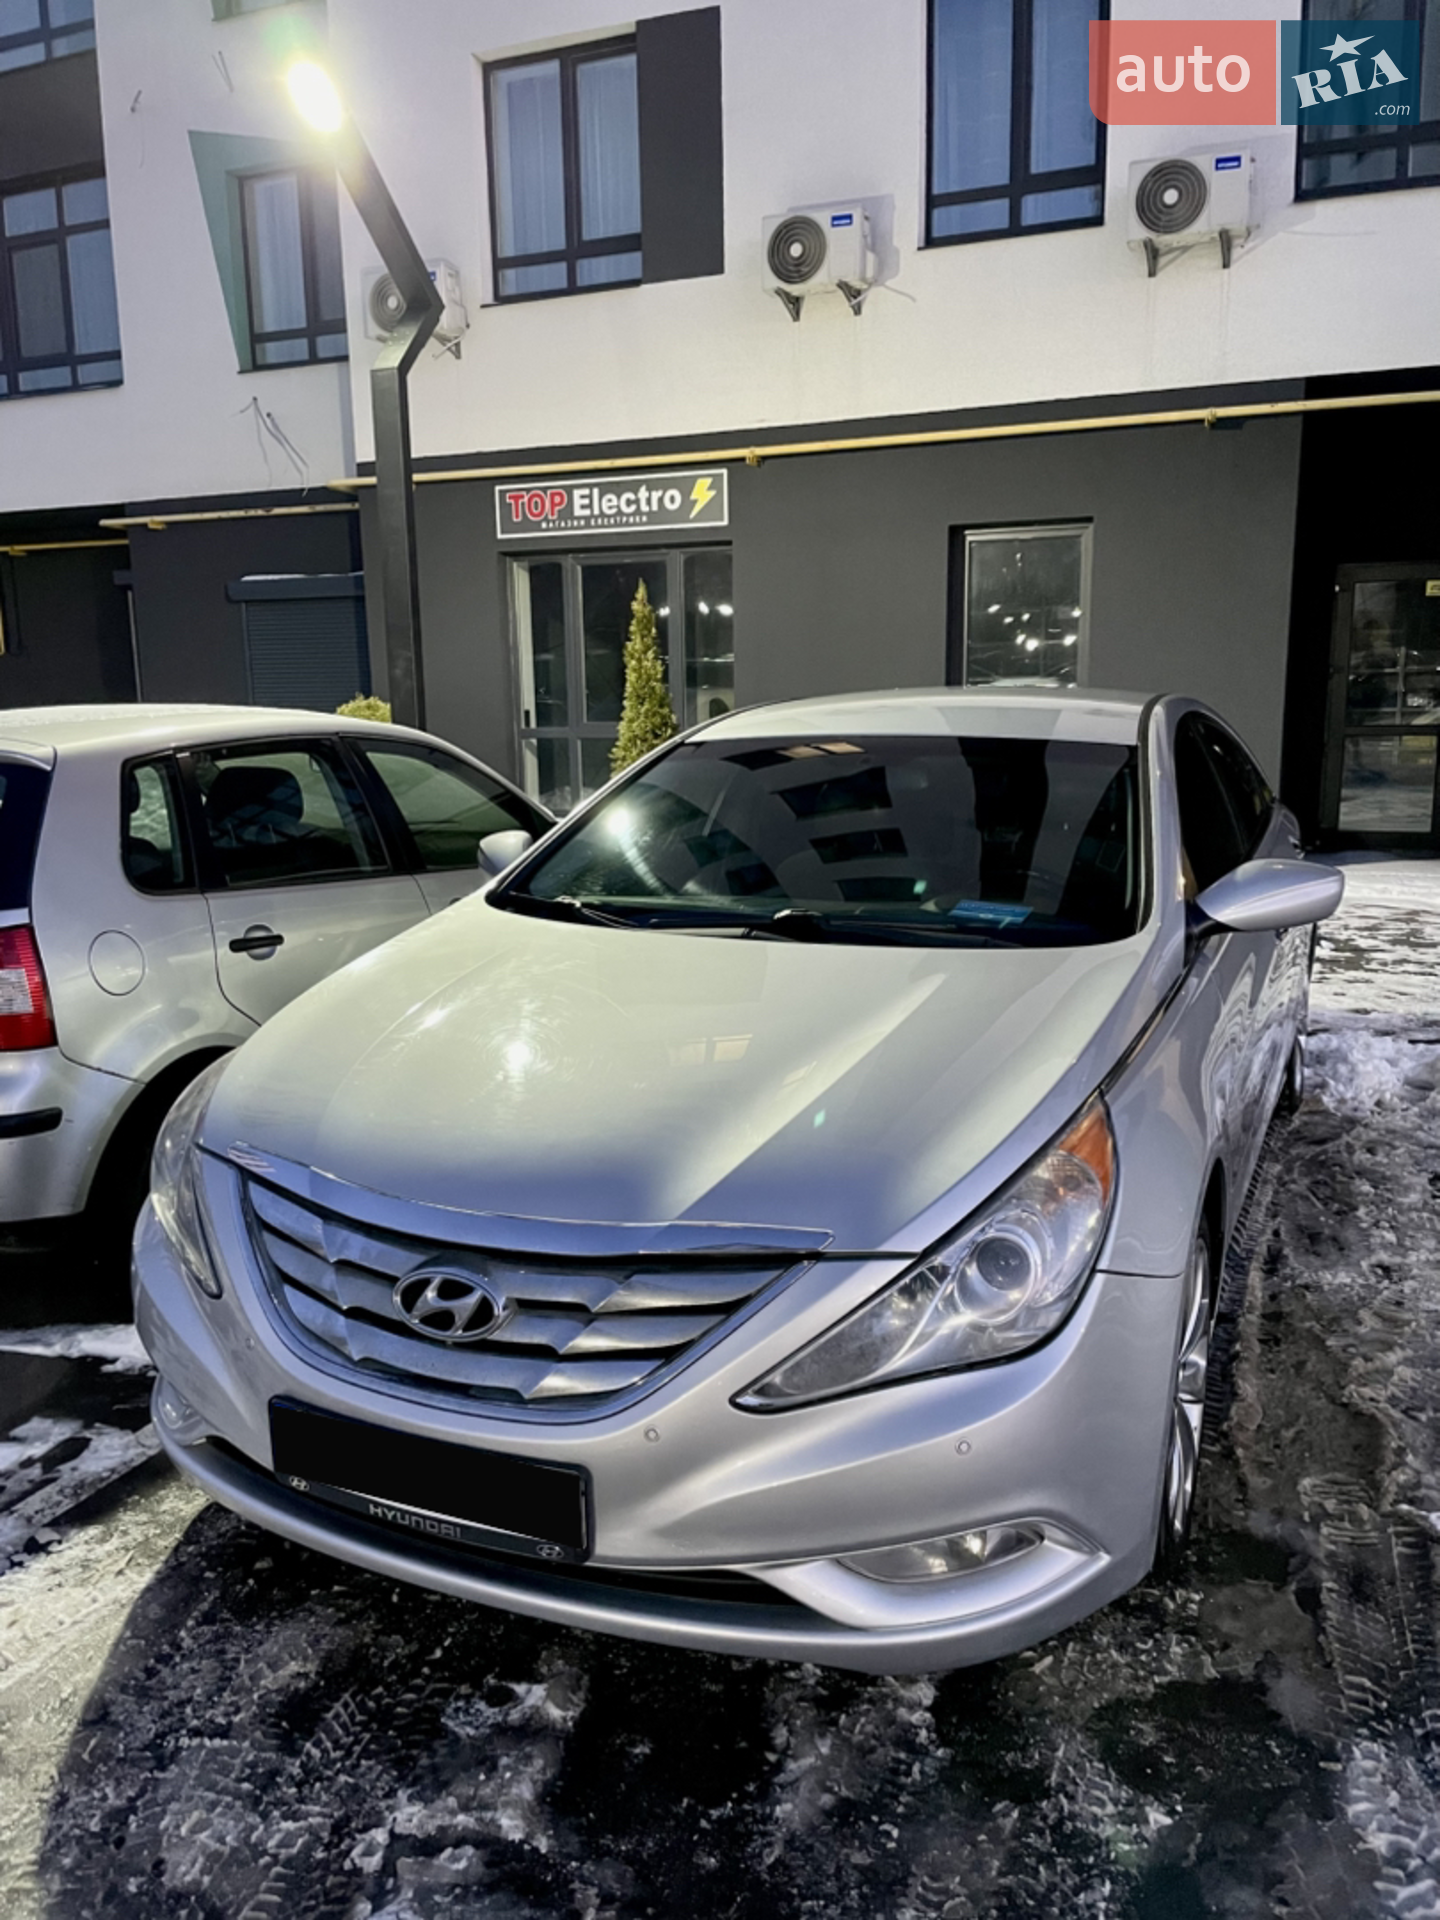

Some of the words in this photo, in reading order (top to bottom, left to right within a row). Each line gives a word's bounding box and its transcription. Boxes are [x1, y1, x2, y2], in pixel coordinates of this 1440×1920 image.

[506, 489, 567, 522] TOP
[572, 484, 682, 516] Electro
[369, 1503, 461, 1538] HYUNDAI
